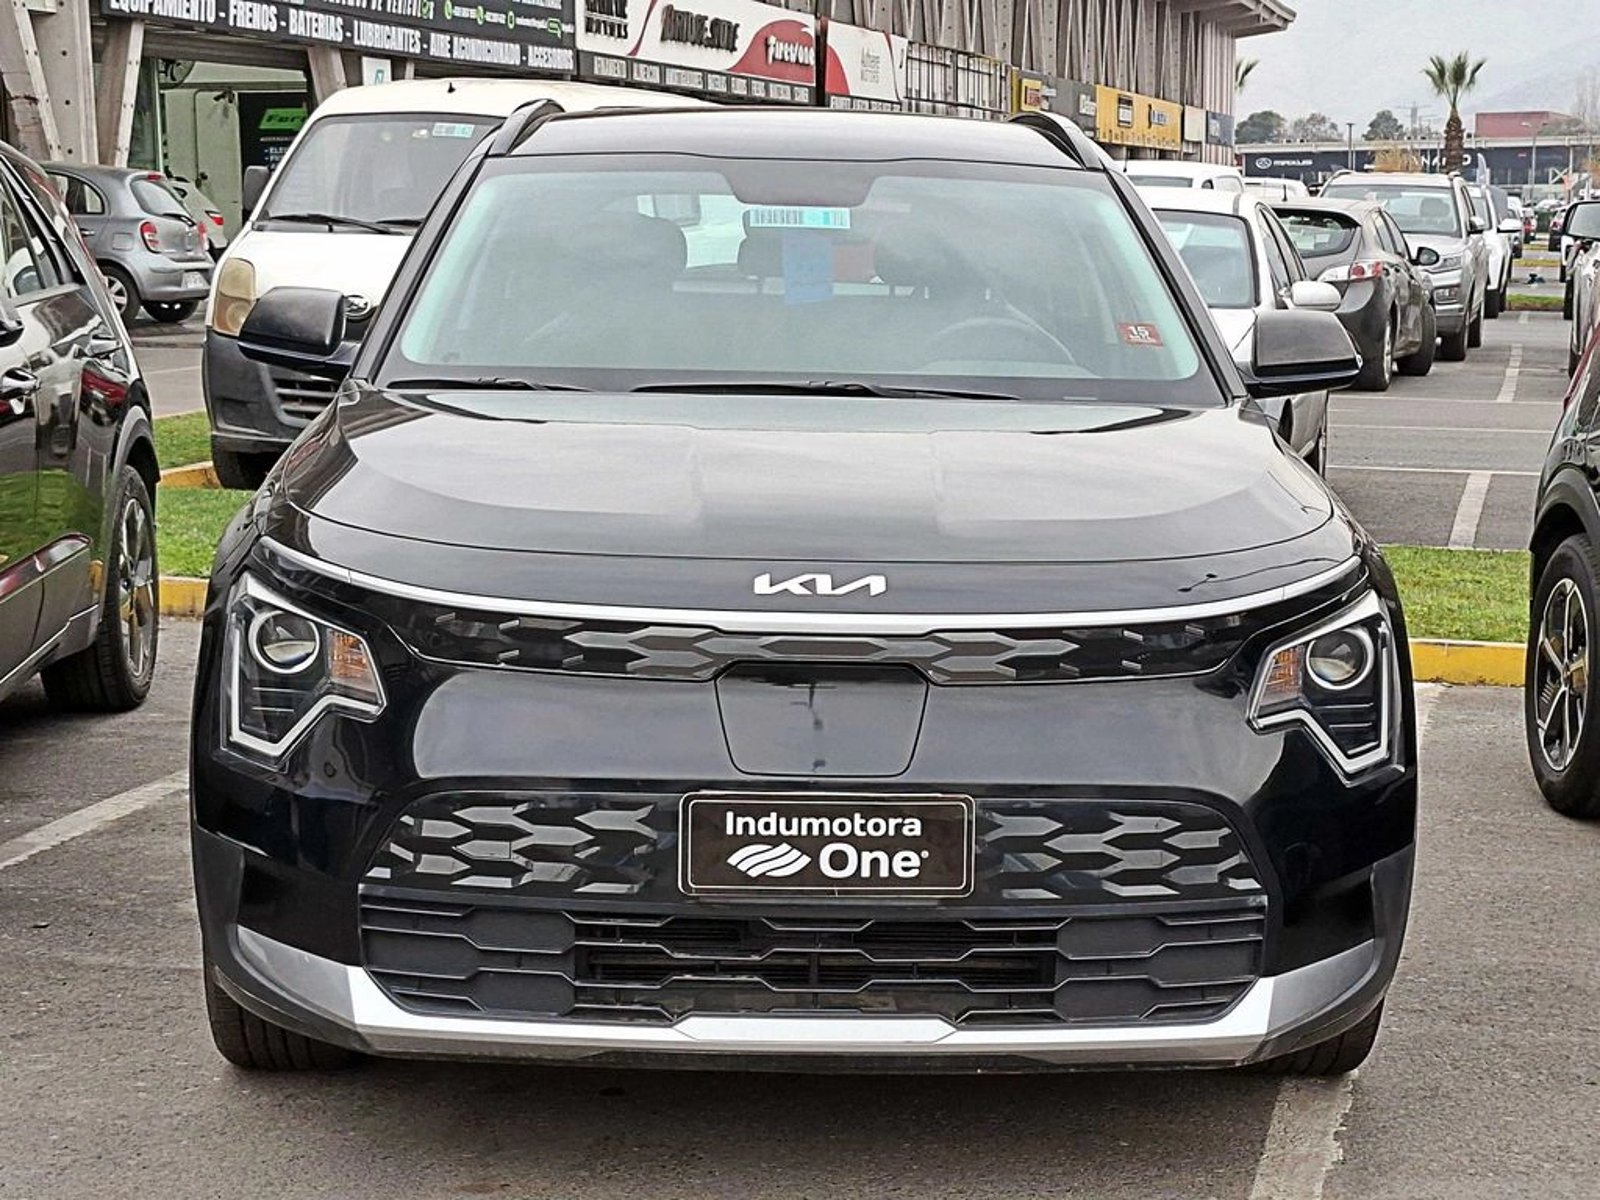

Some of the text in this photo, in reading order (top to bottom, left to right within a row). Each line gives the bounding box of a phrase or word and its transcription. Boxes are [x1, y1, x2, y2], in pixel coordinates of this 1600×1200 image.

[229, 0, 277, 32] FRENOS
[288, 8, 343, 42] BATERIAS
[354, 20, 421, 54] LUBRICANTES
[754, 573, 887, 596] KIA
[726, 811, 922, 837] Indumotora
